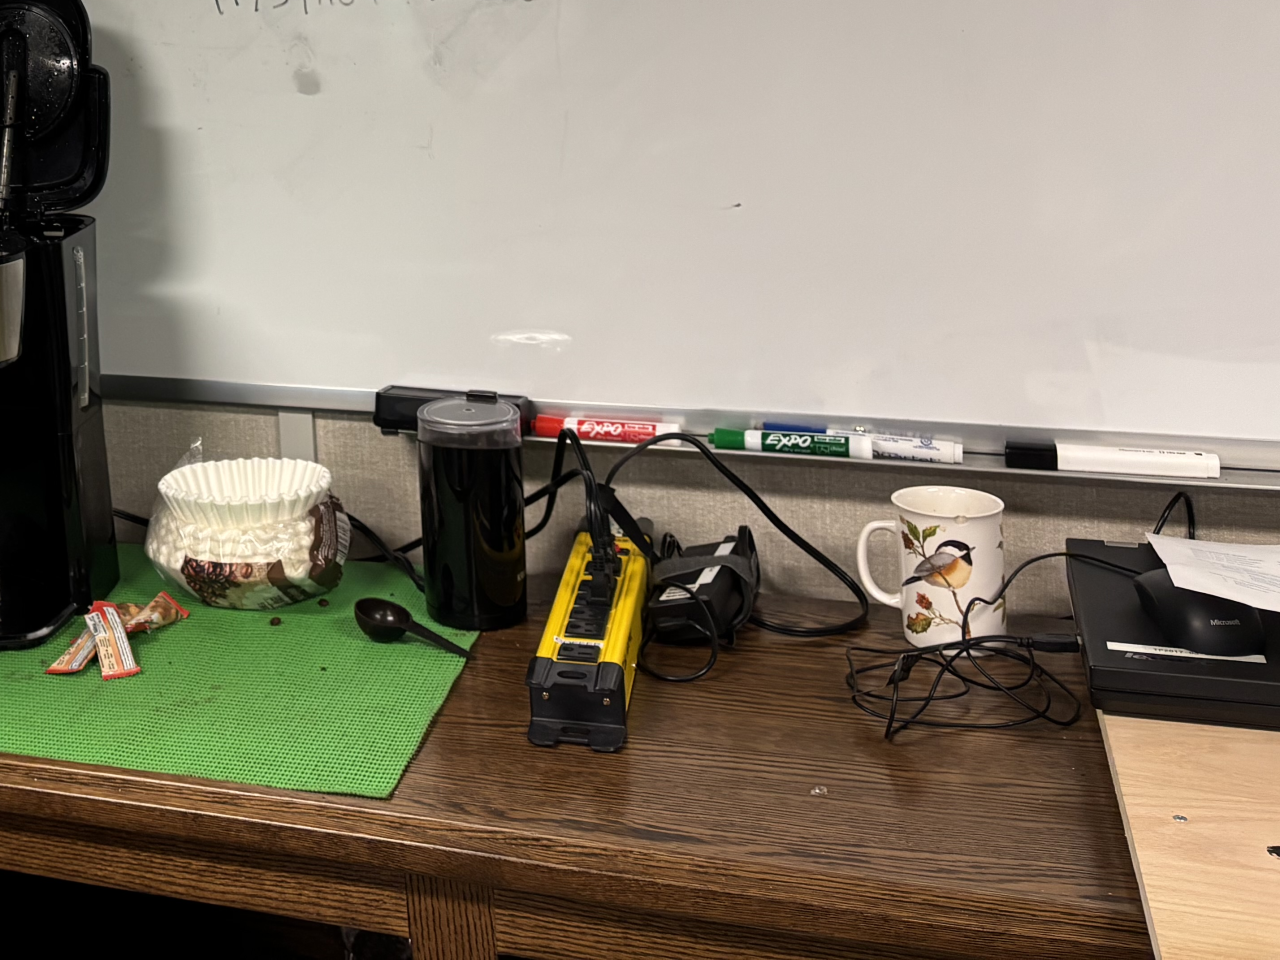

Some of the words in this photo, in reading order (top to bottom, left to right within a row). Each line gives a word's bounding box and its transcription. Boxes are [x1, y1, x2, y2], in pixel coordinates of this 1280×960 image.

[580, 421, 623, 438] EXPO
[765, 433, 813, 451] EXPO
[1210, 619, 1241, 627] Microsoft
